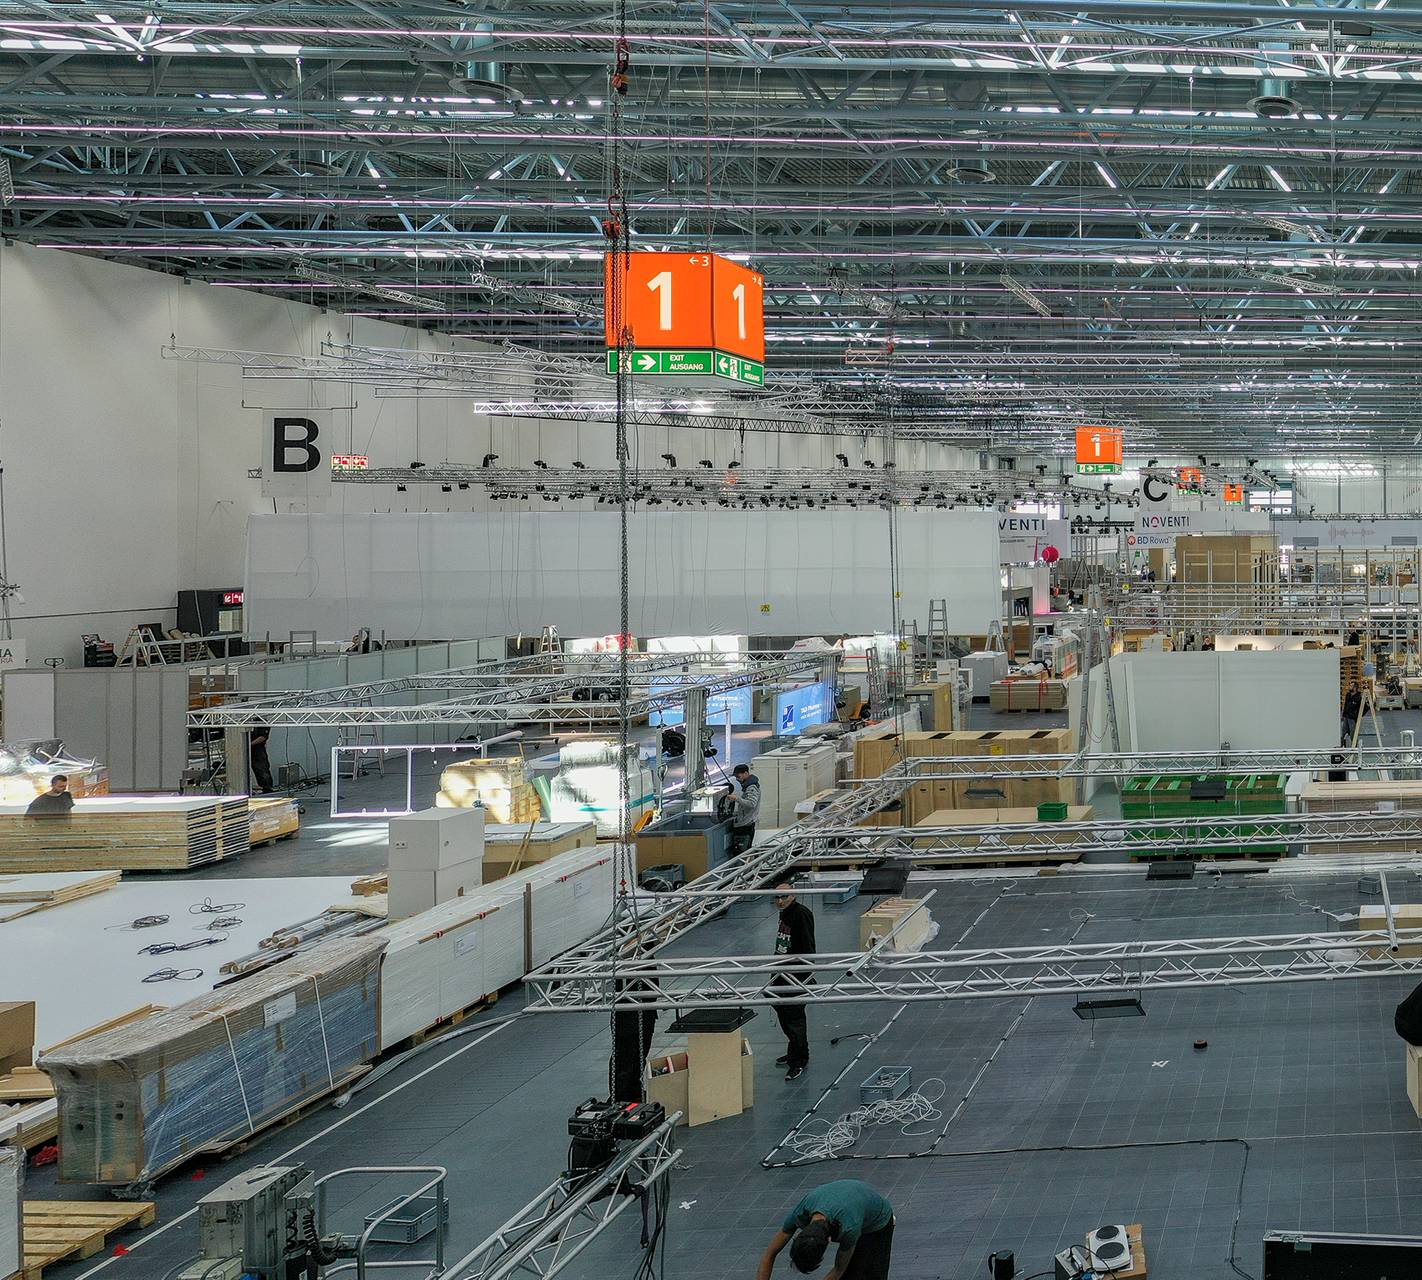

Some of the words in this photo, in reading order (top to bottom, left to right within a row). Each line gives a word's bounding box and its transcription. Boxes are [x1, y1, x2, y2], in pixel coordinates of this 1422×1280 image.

[702, 255, 709, 267] 3
[646, 271, 672, 331] 1
[732, 283, 747, 340] 1
[669, 354, 684, 362] EXIT
[669, 363, 704, 371] AUSGANG
[273, 417, 321, 472] B
[1091, 433, 1100, 457] 1
[1143, 475, 1168, 502] C
[1142, 516, 1190, 528] NOVENTI
[1137, 536, 1149, 544] BD
